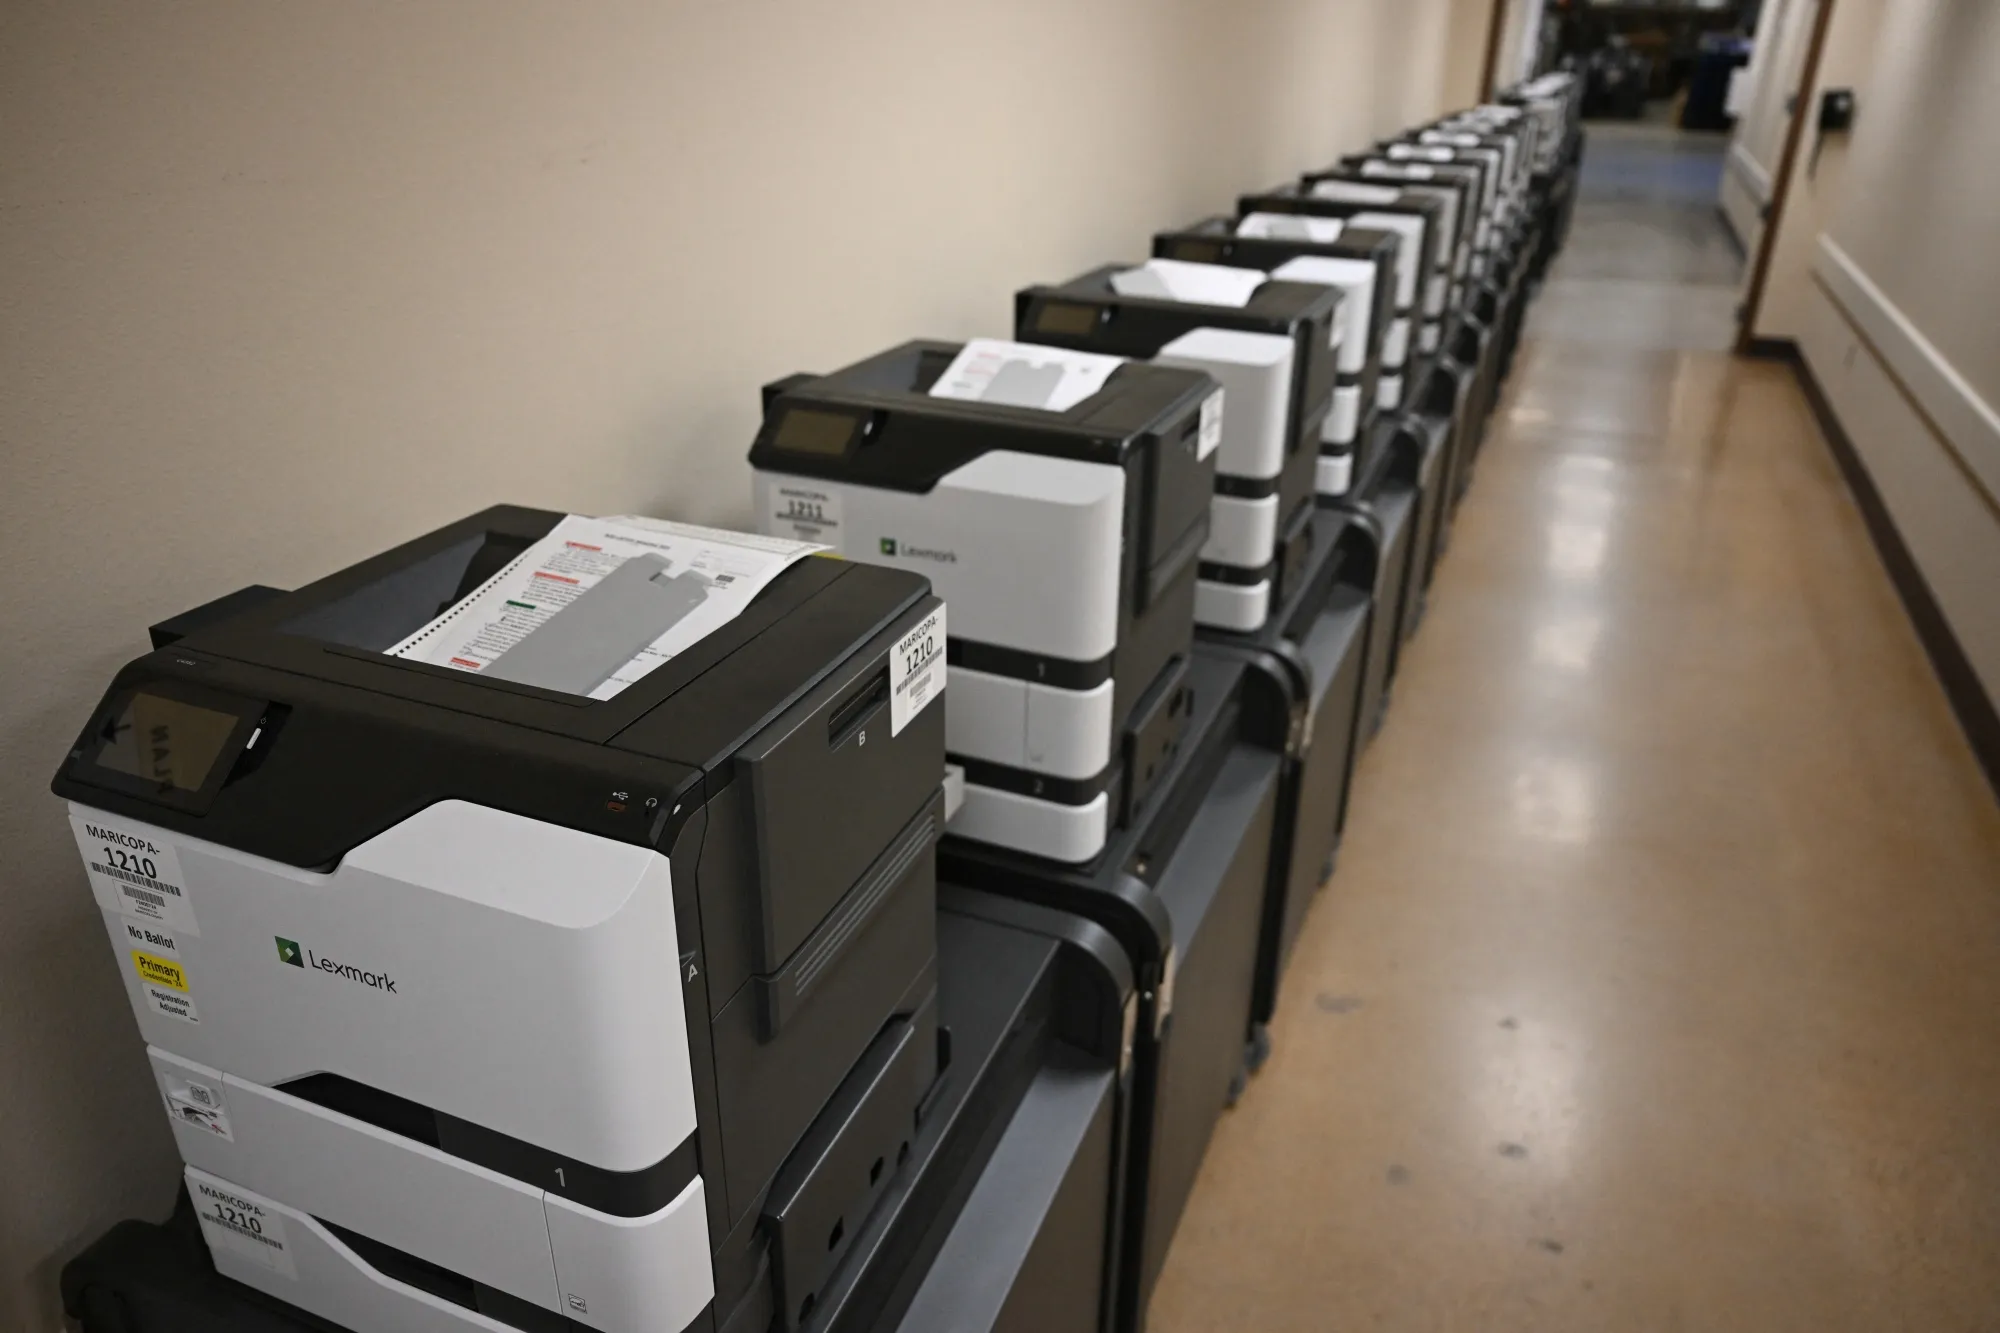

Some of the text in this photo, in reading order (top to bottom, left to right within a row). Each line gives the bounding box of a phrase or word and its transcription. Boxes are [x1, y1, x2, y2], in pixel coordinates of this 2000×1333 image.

[906, 636, 933, 675] 1210
[859, 730, 866, 747] B
[86, 824, 160, 855] MARICOPA-
[104, 847, 157, 879] 1210
[128, 925, 175, 950] No Ballot
[139, 957, 180, 981] Primary
[309, 950, 397, 994] Lexmark
[688, 963, 698, 982] A
[151, 989, 190, 1008] Registration
[159, 1001, 187, 1017] Adjusted
[554, 1167, 566, 1188] 1
[214, 1204, 262, 1234] 1210
